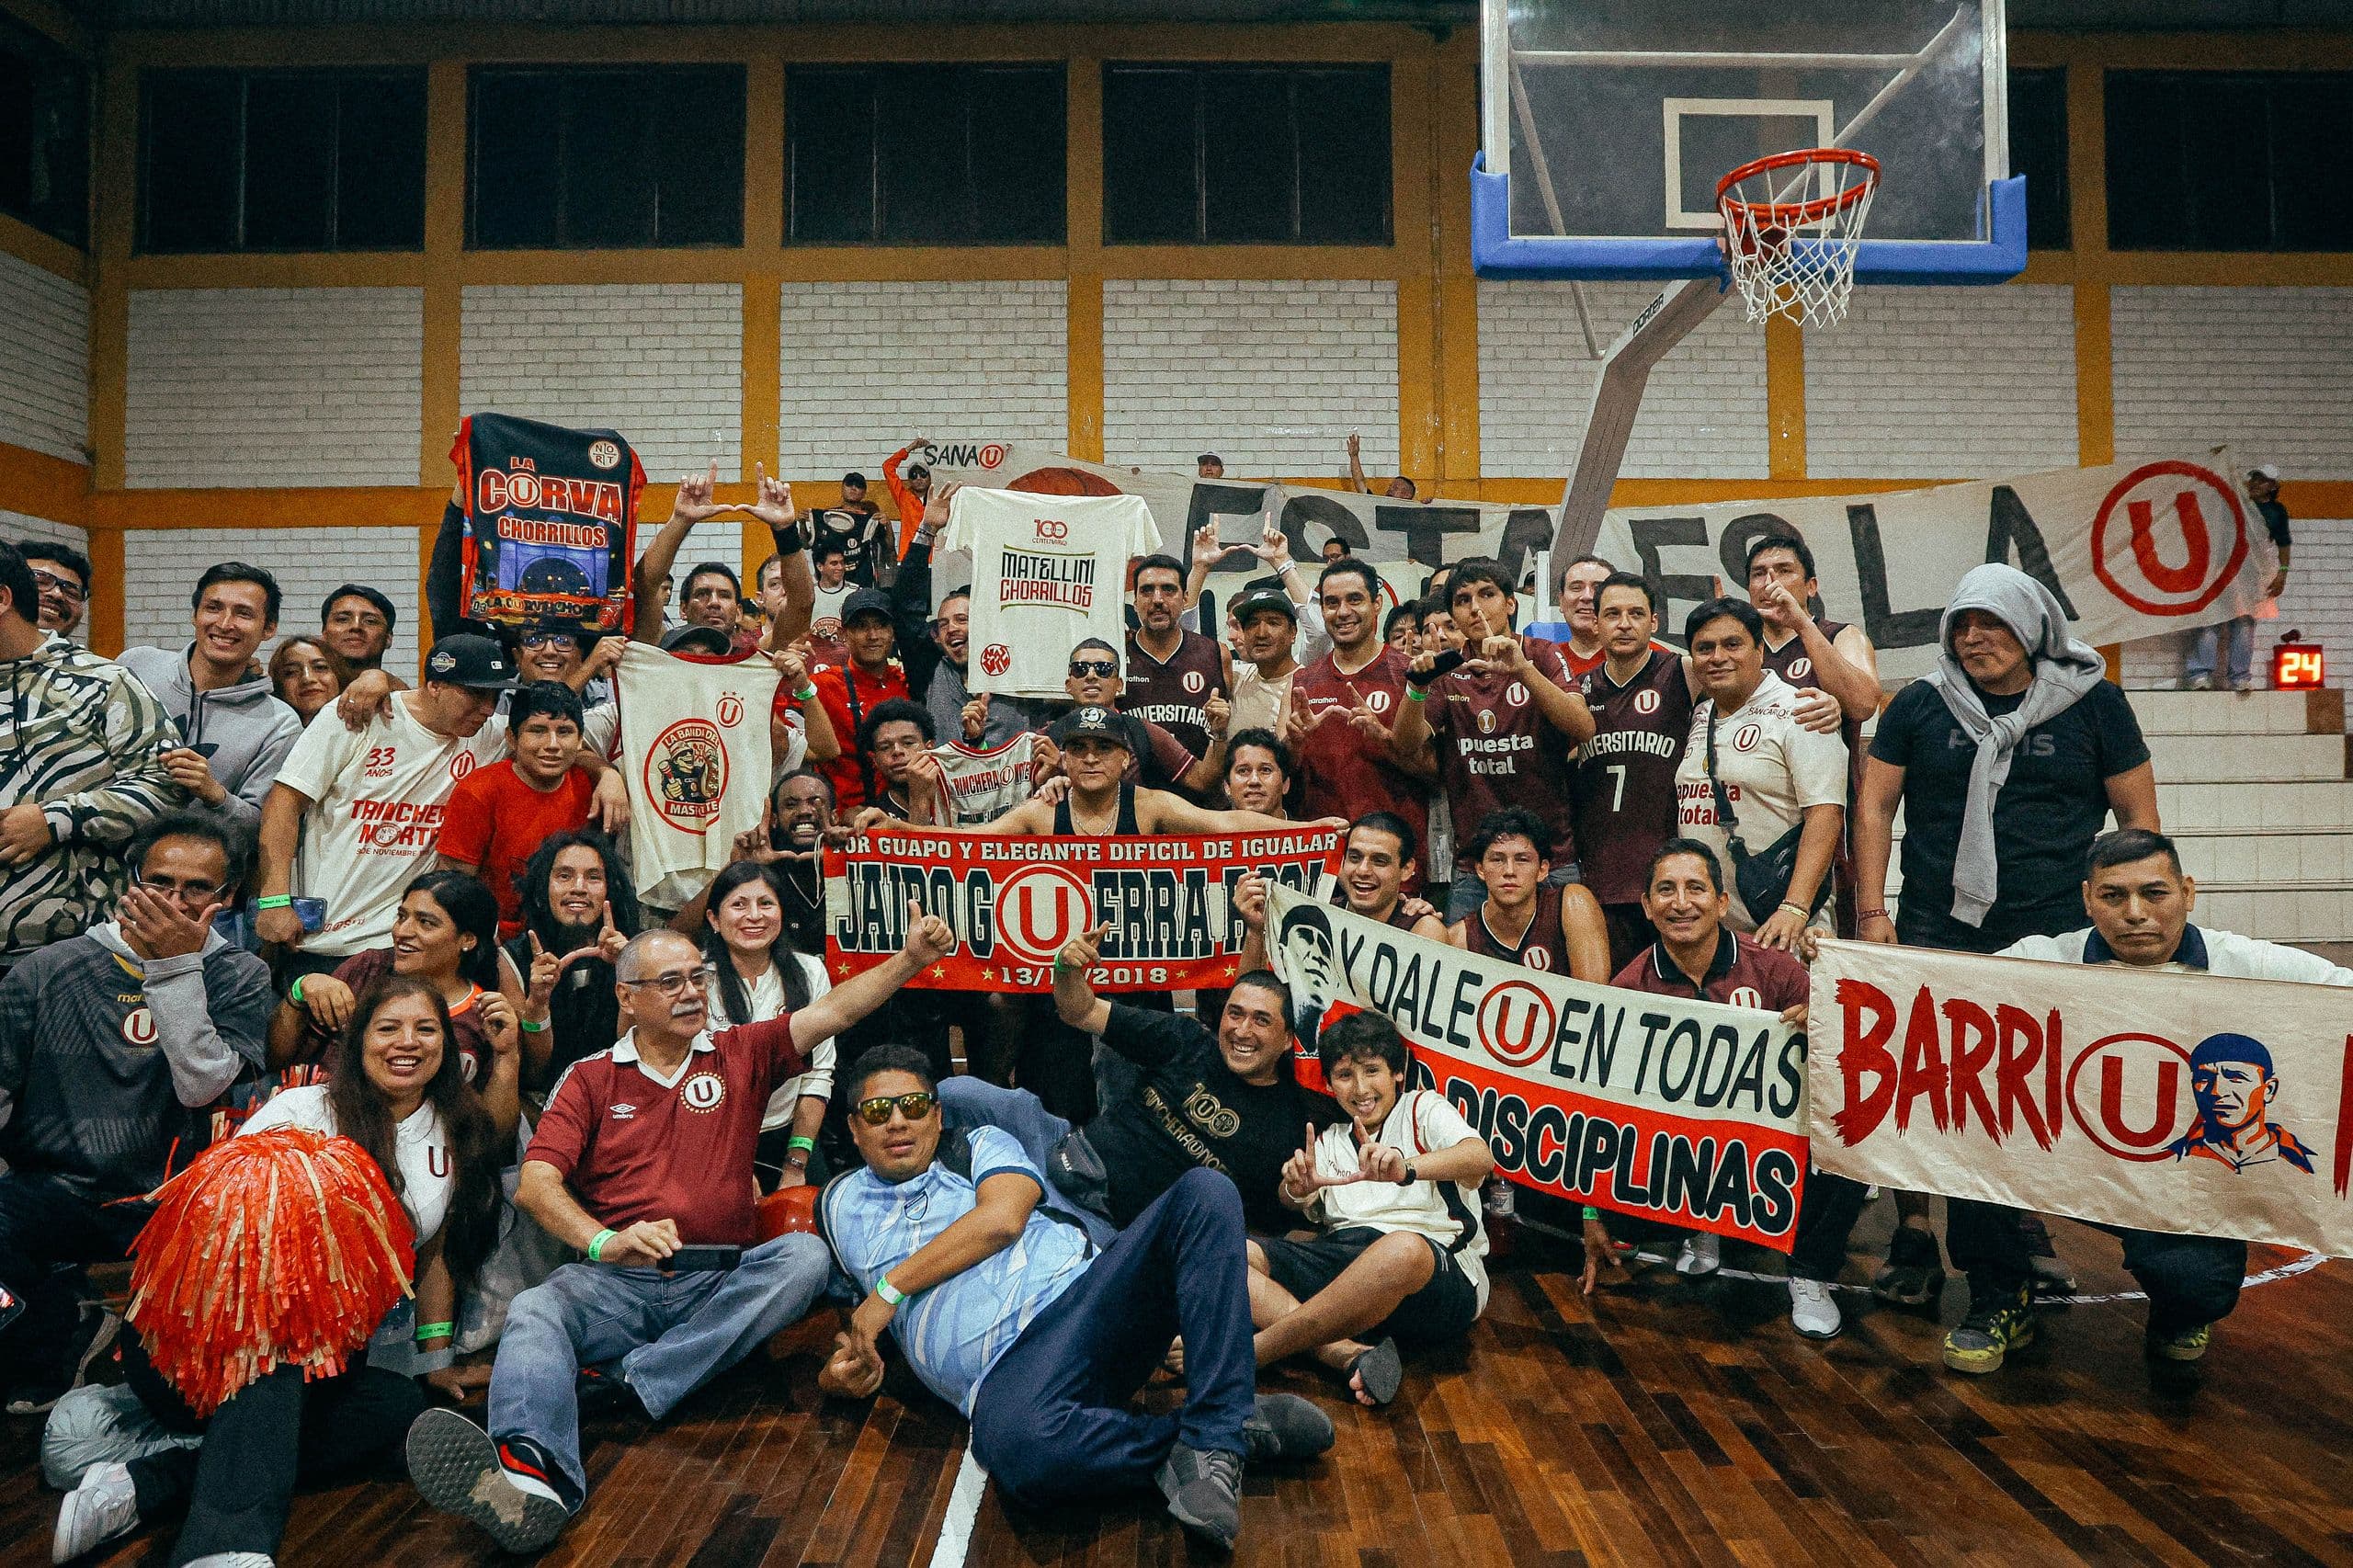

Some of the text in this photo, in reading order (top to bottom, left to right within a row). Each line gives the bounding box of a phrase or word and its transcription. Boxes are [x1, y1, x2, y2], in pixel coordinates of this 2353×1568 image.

[510, 456, 536, 472] LA
[497, 516, 607, 548] CHORRILLOS
[1034, 518, 1068, 540] 100
[1000, 551, 1096, 585] MATELLINI
[1845, 483, 2081, 650] LA
[999, 579, 1093, 608] CHORRILLOS
[2280, 652, 2322, 683] 24
[366, 746, 396, 768] 33
[1468, 756, 1517, 776] total
[952, 770, 1000, 797] RINCHERA
[1606, 764, 1627, 812] 7
[350, 800, 448, 824] TRINCHE
[372, 848, 417, 858] NOVIEMBRE
[833, 832, 1337, 861] OR GUAPO Y ELEGANTE DIFICIL DE IGUALAR
[1001, 966, 1168, 987] 13/1/2018
[1340, 927, 1365, 998] Y
[1373, 941, 1483, 1050] DALE
[1550, 996, 1620, 1088] EN
[1634, 1013, 1809, 1119] TODAS
[428, 1145, 449, 1178] U
[1445, 1074, 1800, 1236] DISCIPLINAS
